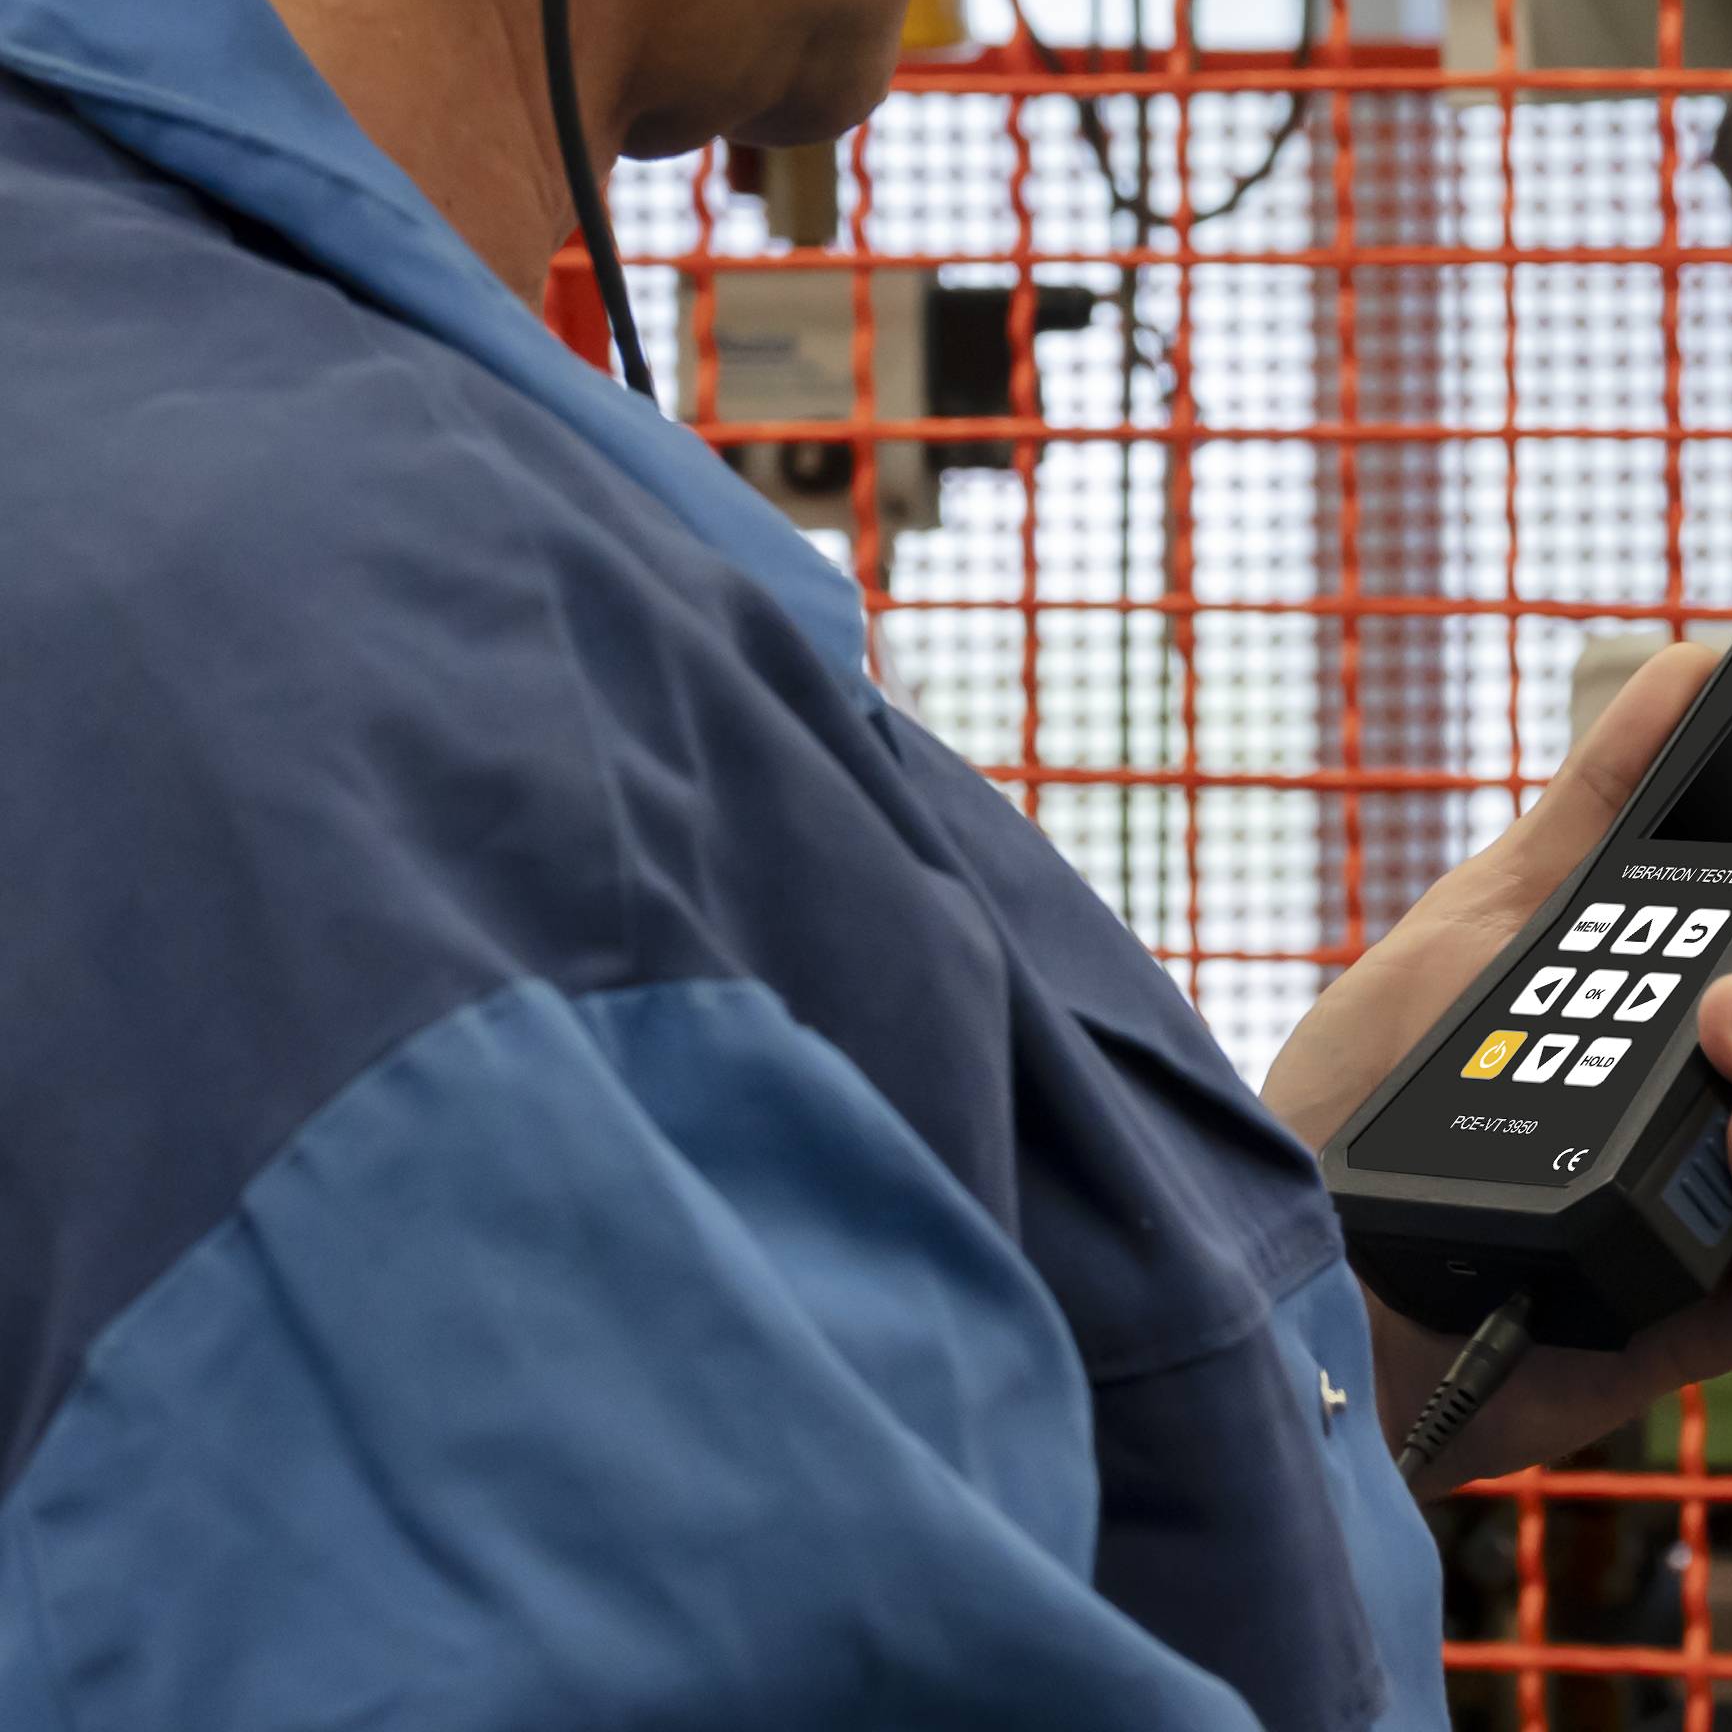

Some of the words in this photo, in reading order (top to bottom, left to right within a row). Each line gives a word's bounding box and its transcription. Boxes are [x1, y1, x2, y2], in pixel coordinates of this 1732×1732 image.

[1621, 864, 1699, 882] VIBRATION
[1573, 920, 1612, 934] MENU
[1585, 988, 1607, 1000] OK
[1579, 1055, 1616, 1068] HOLD
[1449, 1115, 1507, 1133] PCE-VT
[1502, 1119, 1539, 1135] 3950
[1552, 1147, 1590, 1172] CE
